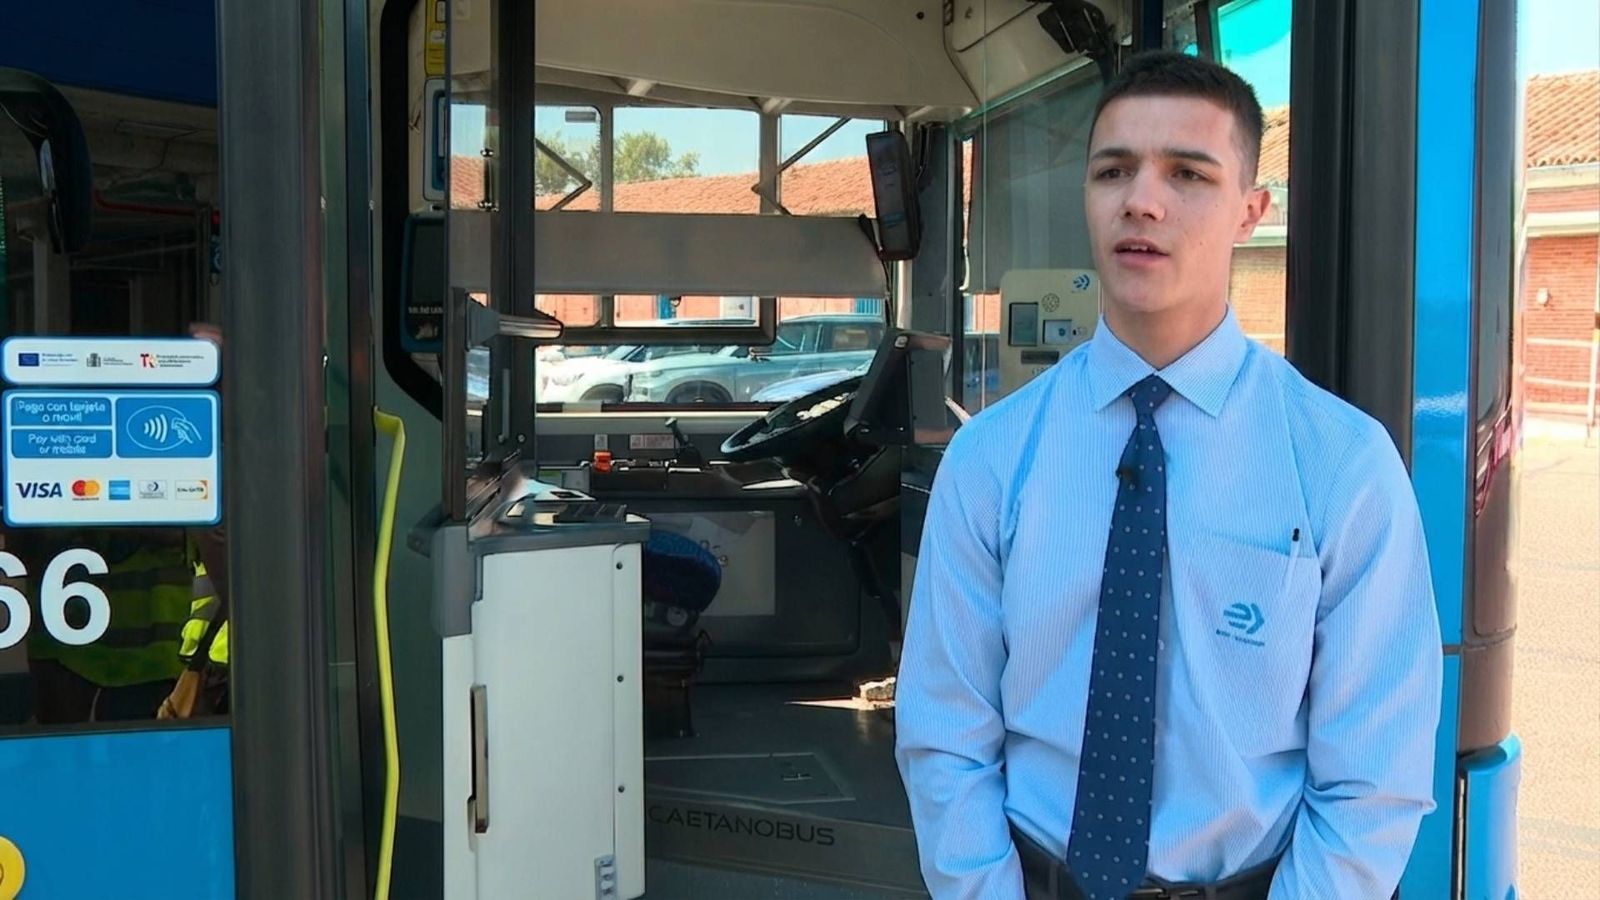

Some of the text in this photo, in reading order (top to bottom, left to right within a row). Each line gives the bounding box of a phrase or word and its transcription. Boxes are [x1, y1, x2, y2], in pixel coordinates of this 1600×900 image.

[46, 403, 68, 412] con
[42, 414, 50, 423] o
[28, 433, 47, 445] Pay
[15, 482, 63, 499] VISA
[648, 806, 836, 847] CAETANOBUS
